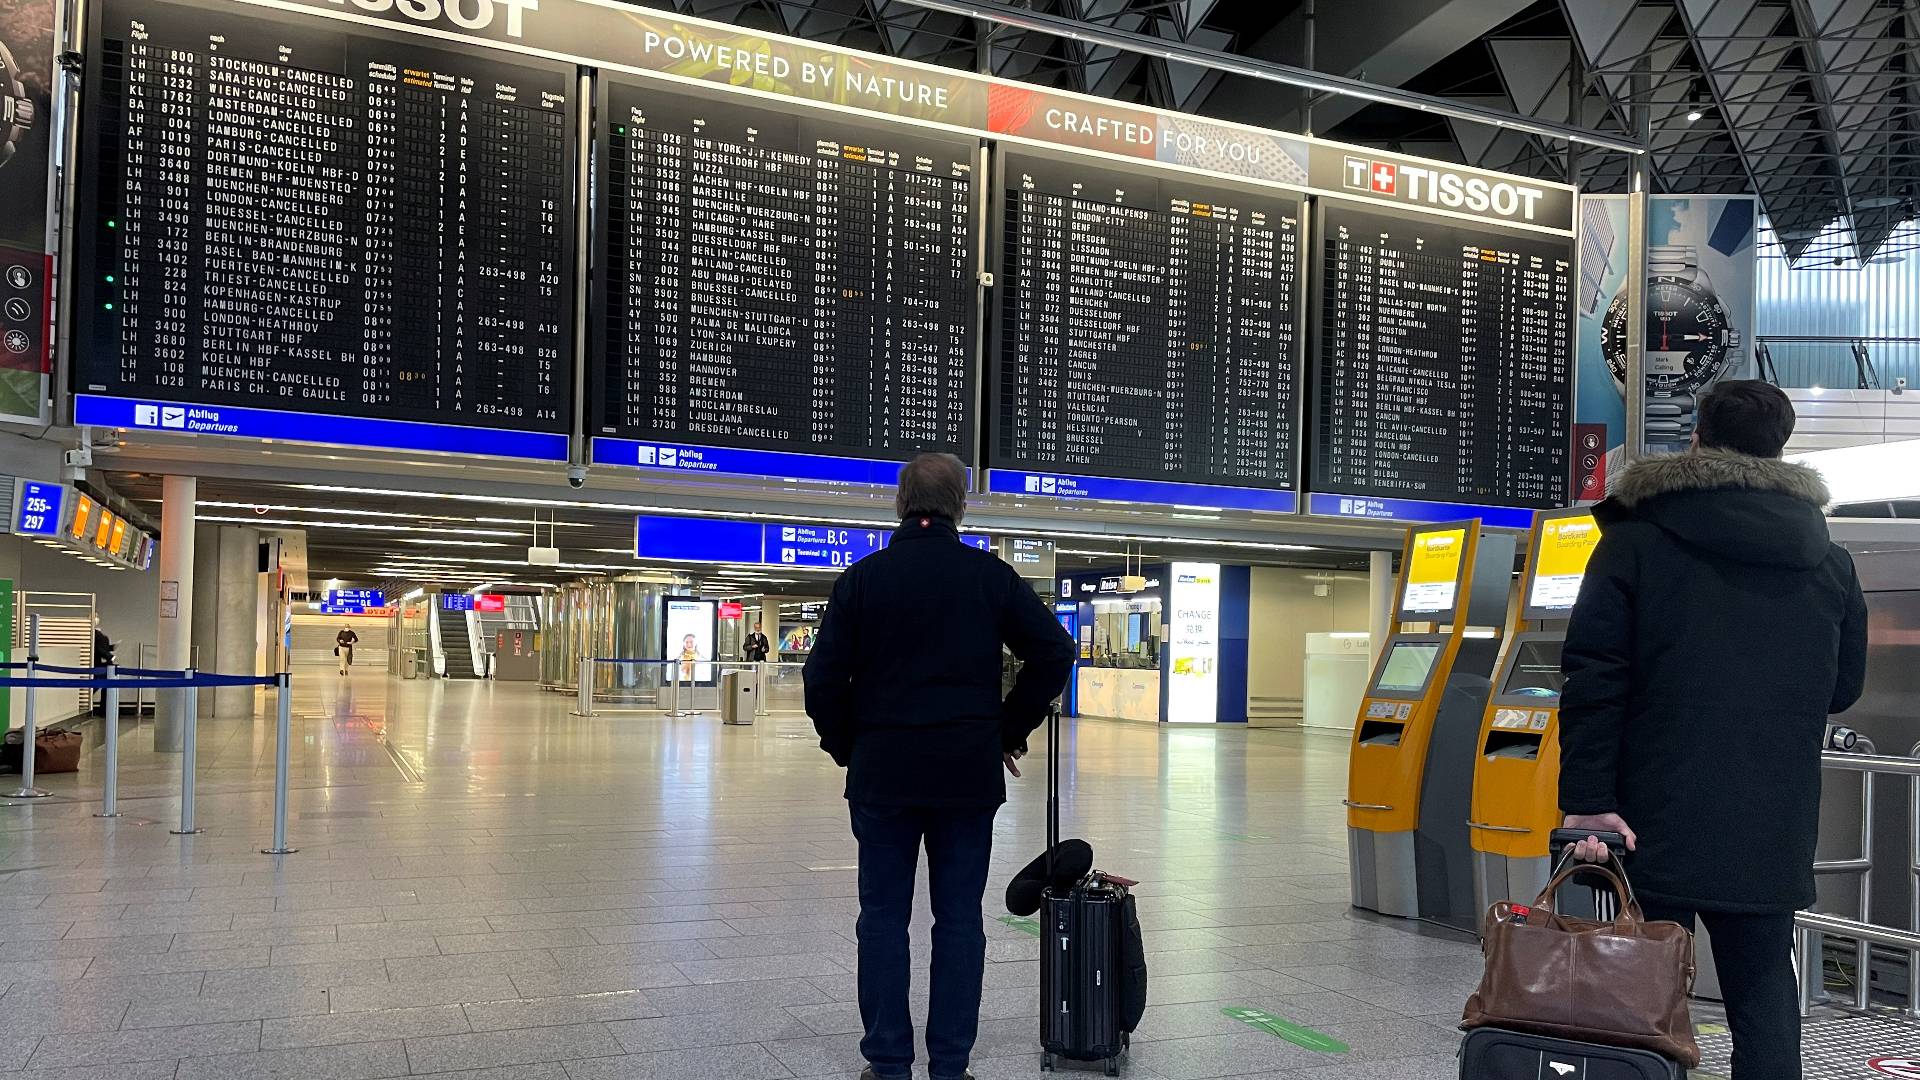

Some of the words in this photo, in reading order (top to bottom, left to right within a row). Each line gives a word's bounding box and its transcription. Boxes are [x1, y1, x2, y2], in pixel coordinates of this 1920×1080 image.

[131, 21, 144, 31] Flug
[131, 30, 148, 40] Flight
[210, 56, 354, 89] STOCKHOLM-CANCELLED
[404, 68, 430, 79] erwartet
[433, 72, 454, 83] Terminal
[645, 32, 790, 78] POWERED
[802, 63, 834, 86] BY
[846, 71, 948, 108] NATURE
[209, 70, 346, 101] SARAJEVO-CANCELLED
[403, 77, 432, 88] estimated
[433, 82, 455, 91] Terminal
[496, 83, 517, 94] Schalter
[209, 83, 316, 109] WIEN-CANCELLED
[496, 92, 516, 102] Counter
[209, 97, 353, 128] AMSTERDAM-CANCELLED
[208, 110, 331, 138] LONDON-CANCELLED
[208, 124, 338, 152] HAMBURG-CANCELLED
[1045, 108, 1153, 145] CRAFTED
[1163, 130, 1206, 154] FOR
[1216, 140, 1260, 164] YOU
[208, 137, 322, 163] PARIS-CANCELLED
[693, 138, 711, 150] NEW
[717, 142, 811, 165] YORK-J.F.KENNEDY
[207, 150, 315, 175] DORTMUND-KOELN
[322, 166, 359, 181] HBF-D
[207, 164, 253, 180] BREMEN
[693, 162, 723, 175] NIZZA
[207, 177, 344, 205] MUENCHEN-NUERNBERG
[693, 174, 729, 188] AACHEN
[735, 180, 788, 197] HBF-KOELN
[793, 189, 811, 200] HBF
[1400, 166, 1543, 220] TISSOT
[206, 191, 329, 216] LONDON-CANCELLED
[692, 198, 810, 223] MUENCHEN-WUERZBURG-N
[206, 204, 343, 231] BRUESSEL-CANCELLED
[692, 209, 746, 226] CHICAGO-O
[752, 218, 775, 230] HARE
[206, 218, 358, 246] MUENCHEN-WUERZBURG-N
[205, 231, 342, 257] BERLIN-BRANDENBURG
[205, 244, 244, 259] BASEL
[252, 250, 357, 272] BAD-MANNHEIM-K
[691, 245, 786, 266] BERLIN-CANCELLED
[204, 258, 349, 284] FUERTEVEN-CANCELLED
[691, 257, 792, 279] MAILAND-CANCELLED
[204, 271, 327, 295] TRIEST-CANCELLED
[691, 269, 709, 280] ABU
[715, 272, 792, 290] DHABI-DELAYED
[204, 285, 341, 309] KOPENHAGEN-KASTRUP
[691, 293, 739, 307] BRUESSEL
[203, 298, 333, 321] HAMBURG-CANCELLED
[203, 325, 272, 342] STUTTGART
[280, 333, 303, 345] HBF
[690, 316, 720, 329] PALMA
[726, 320, 738, 330] DE
[744, 322, 791, 336] MALLORCA
[202, 339, 249, 353] BERLIN
[257, 344, 332, 361] HBF-KASSEL
[340, 351, 355, 363] BH
[690, 340, 732, 353] ZUERICH
[202, 352, 241, 366] KOELN
[249, 356, 272, 368] HBF
[690, 364, 738, 377] HANNOVER
[202, 366, 339, 387] MUENCHEN-CANCELLED
[201, 379, 240, 392] PARIS
[248, 383, 271, 395] CH.
[279, 386, 294, 397] DE
[302, 387, 346, 401] GAULLE
[689, 387, 743, 401] AMSTERDAM
[188, 409, 219, 422] Abflug
[689, 399, 778, 416] WROCLAW/BRESLAU
[188, 420, 238, 432] Departures
[689, 423, 789, 440] DRESDEN-CANCELLED
[679, 449, 702, 460] Abflug
[679, 459, 717, 470] Departures
[1057, 487, 1088, 496] Departures
[1058, 478, 1077, 488] Abflug
[26, 498, 51, 512] 255-
[24, 515, 44, 529] 297
[797, 528, 815, 536] Abflug
[827, 530, 848, 546] B,C
[797, 536, 826, 544] Departures
[1177, 610, 1212, 619] CHANGE
